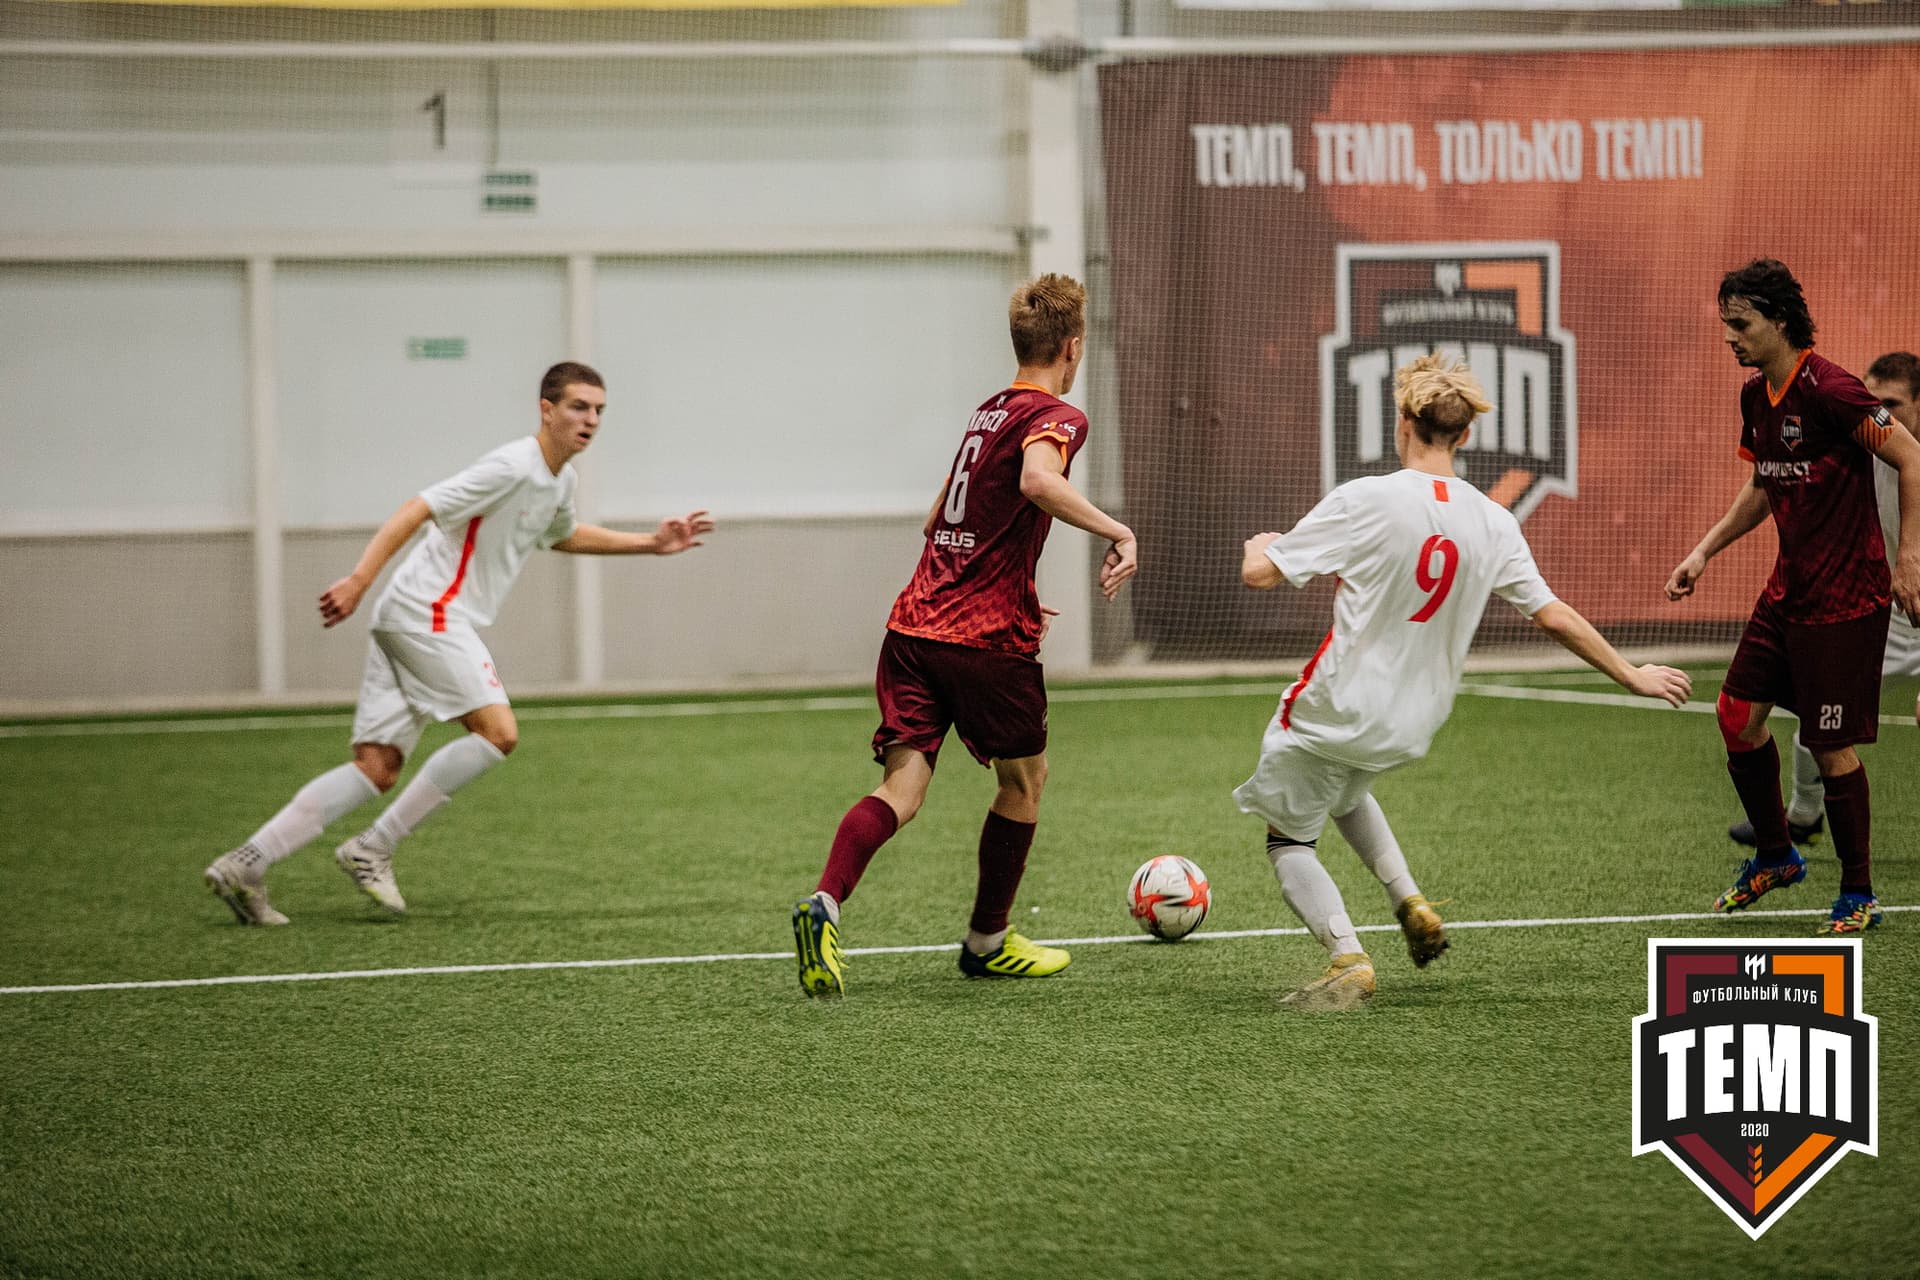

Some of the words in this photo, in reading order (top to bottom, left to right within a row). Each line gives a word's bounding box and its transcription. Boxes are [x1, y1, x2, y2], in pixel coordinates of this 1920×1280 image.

[423, 93, 446, 150] 1
[1191, 122, 1306, 193] ТЕМП,
[1311, 121, 1428, 192] ТЕМП,
[1434, 118, 1584, 184] ТОЛЬКО
[1590, 116, 1704, 182] ТЕМП!
[944, 434, 983, 525] 6
[1407, 533, 1459, 623] 9
[1819, 704, 1843, 730] 23
